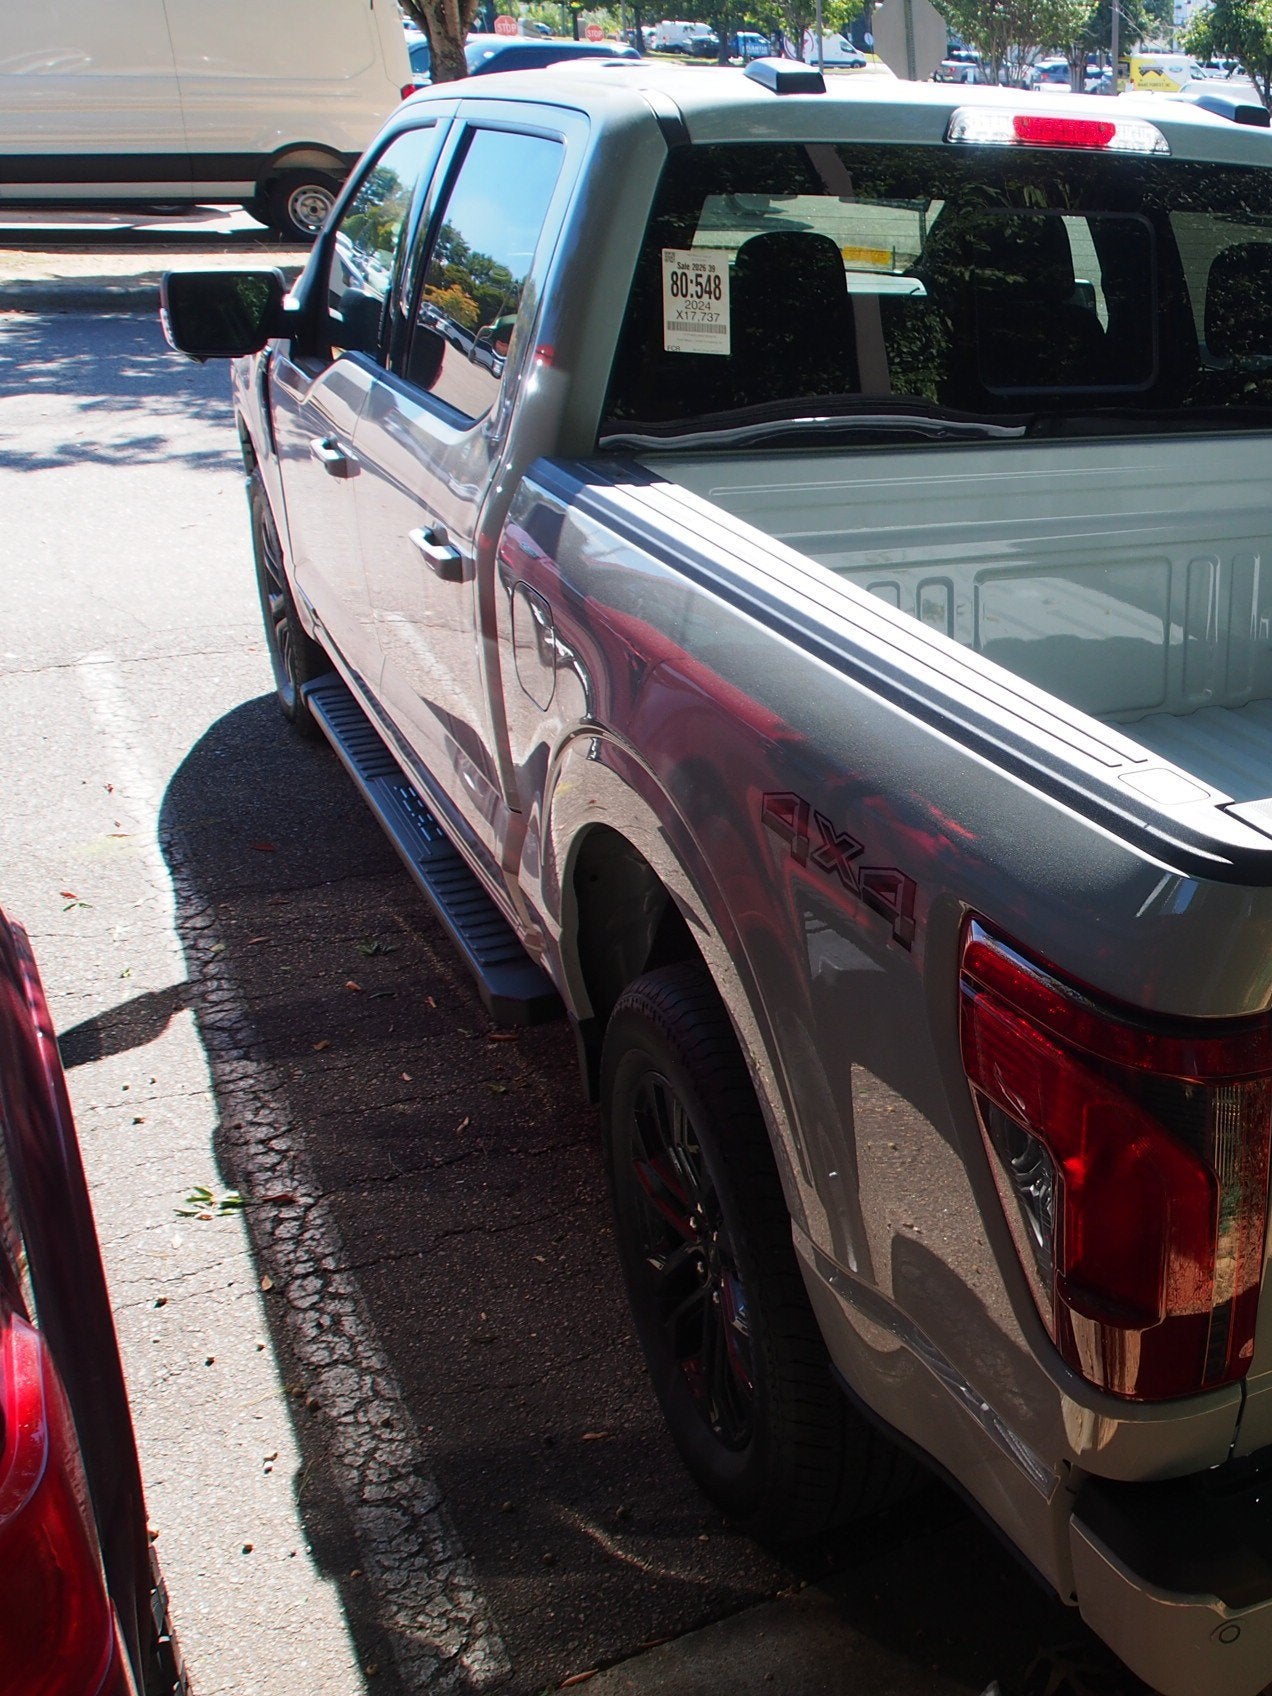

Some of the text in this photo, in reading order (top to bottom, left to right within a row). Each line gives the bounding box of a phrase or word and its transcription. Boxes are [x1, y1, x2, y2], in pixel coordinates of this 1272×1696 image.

[497, 22, 516, 32] STOP
[677, 261, 690, 270] Sale
[670, 270, 722, 301] 80:548
[684, 300, 711, 311] 2024
